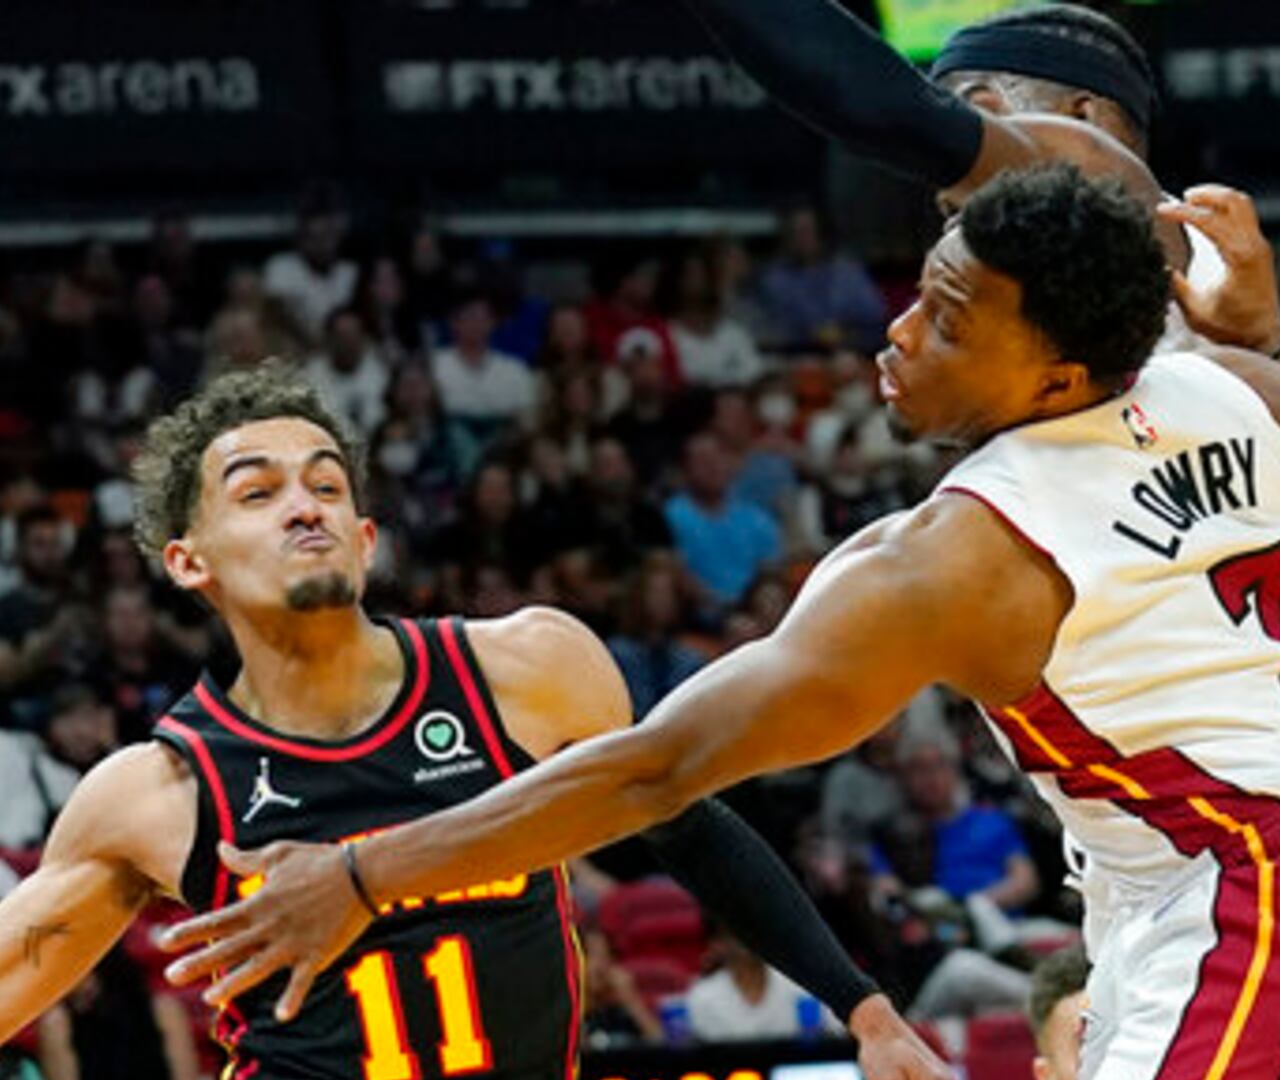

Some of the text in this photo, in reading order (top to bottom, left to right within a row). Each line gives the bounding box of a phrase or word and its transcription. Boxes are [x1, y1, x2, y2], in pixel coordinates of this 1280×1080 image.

[55, 56, 260, 115] arena
[448, 53, 769, 113] FTX arena
[1112, 437, 1257, 560] LOWRY
